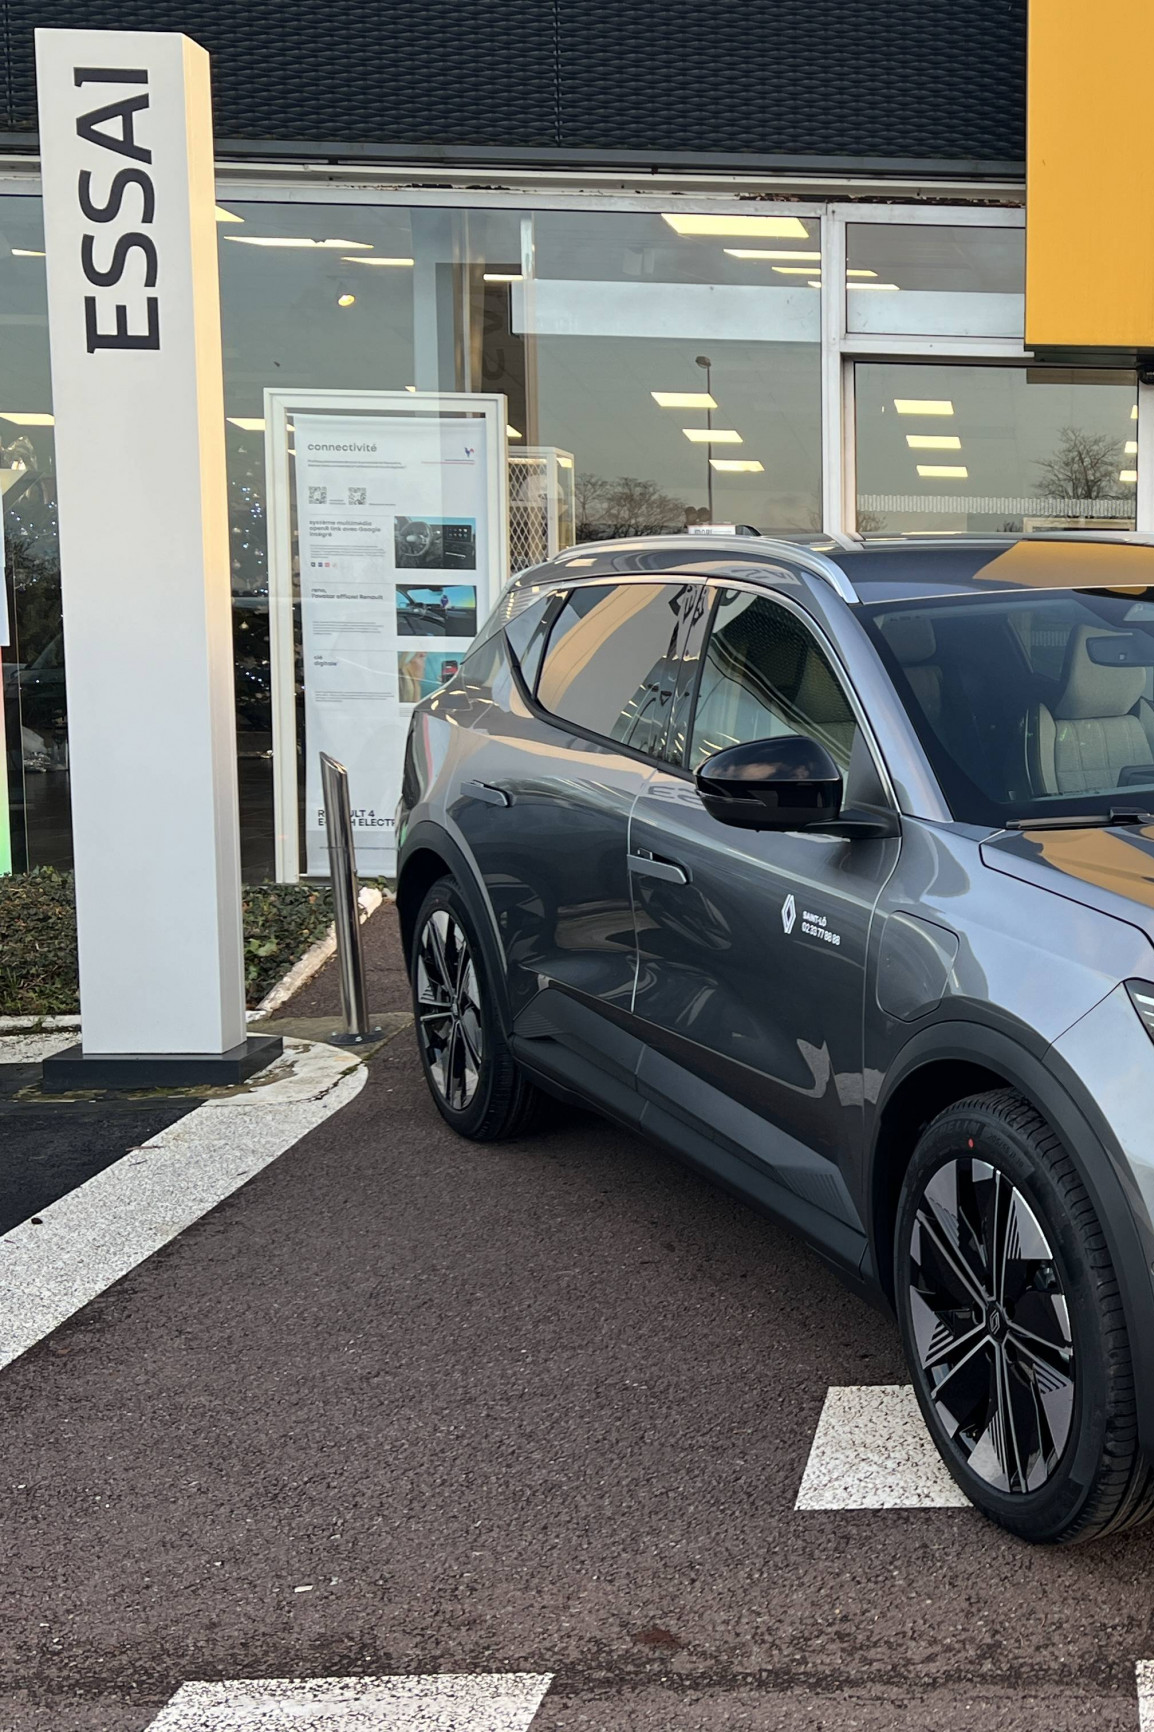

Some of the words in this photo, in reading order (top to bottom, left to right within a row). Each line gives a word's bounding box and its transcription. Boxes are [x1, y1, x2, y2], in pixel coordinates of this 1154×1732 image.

[73, 66, 161, 354] ESSAI
[307, 442, 378, 453] connectivité
[368, 809, 375, 817] 4
